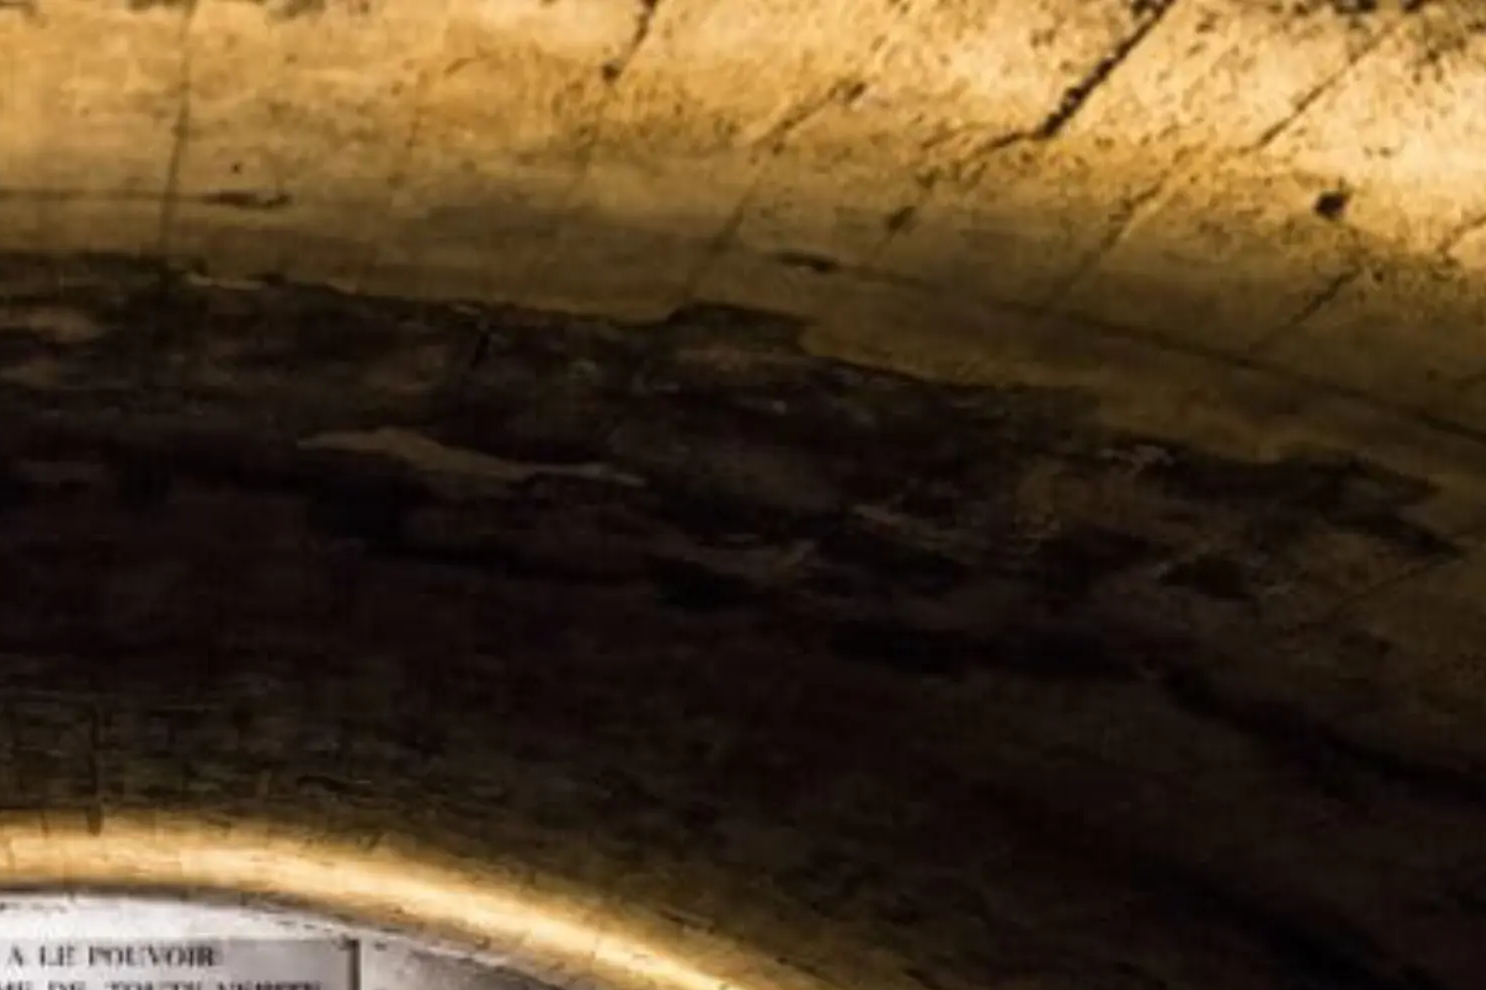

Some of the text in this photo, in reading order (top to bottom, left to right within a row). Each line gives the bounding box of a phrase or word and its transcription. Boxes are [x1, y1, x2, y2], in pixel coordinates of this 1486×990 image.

[7, 944, 25, 966] A
[40, 944, 77, 967] LE
[88, 944, 223, 967] POUVOIR
